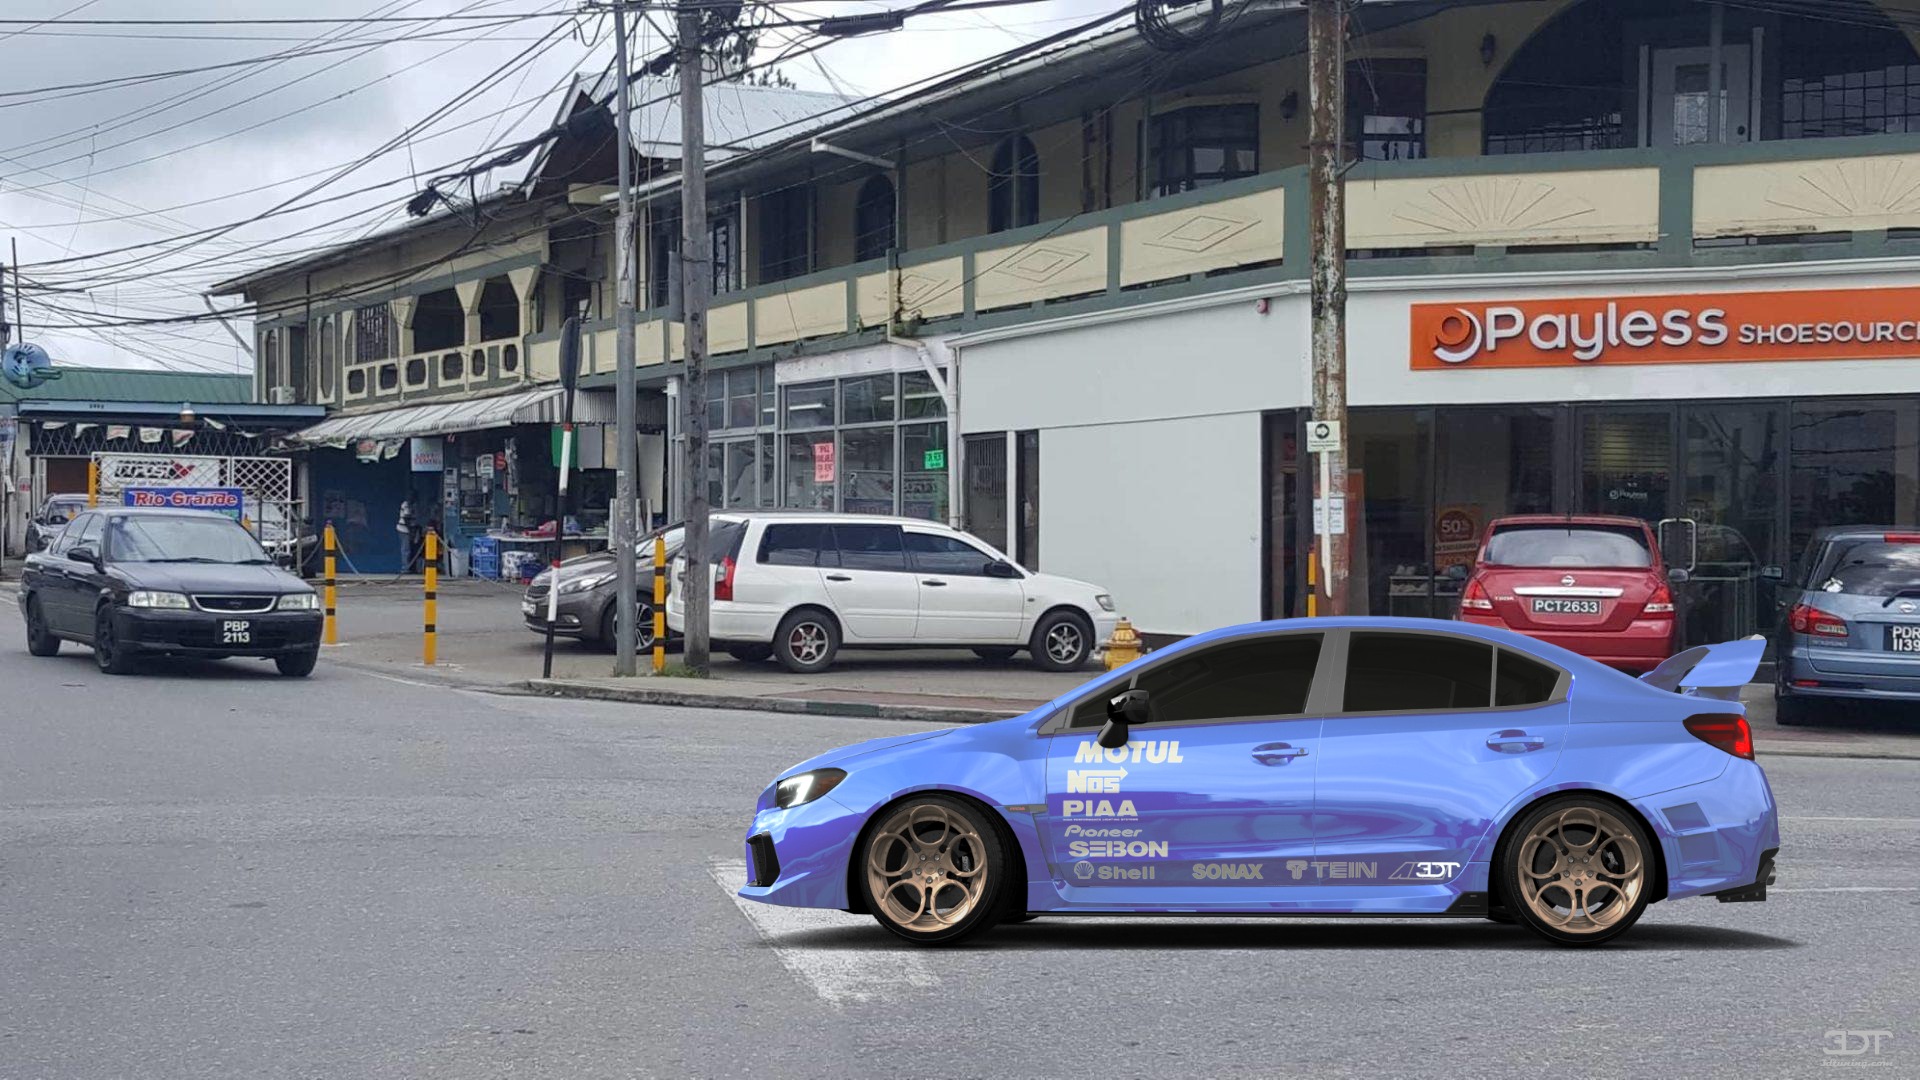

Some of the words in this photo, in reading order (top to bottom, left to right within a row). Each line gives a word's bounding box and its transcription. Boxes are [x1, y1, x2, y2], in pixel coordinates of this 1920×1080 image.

[1486, 302, 1728, 361] Payless
[1534, 600, 1598, 613] PCT2633
[224, 621, 249, 631] PBP
[223, 632, 250, 643] 2113
[1074, 740, 1184, 764] MOTUL
[1062, 800, 1138, 817] PIAA
[1064, 824, 1142, 837] Pioneer
[1068, 841, 1168, 857] SEIBON
[1098, 865, 1155, 880] Shell
[1192, 863, 1264, 880] SONAX
[1311, 861, 1377, 879] TEIN
[1416, 862, 1461, 878] 3DT
